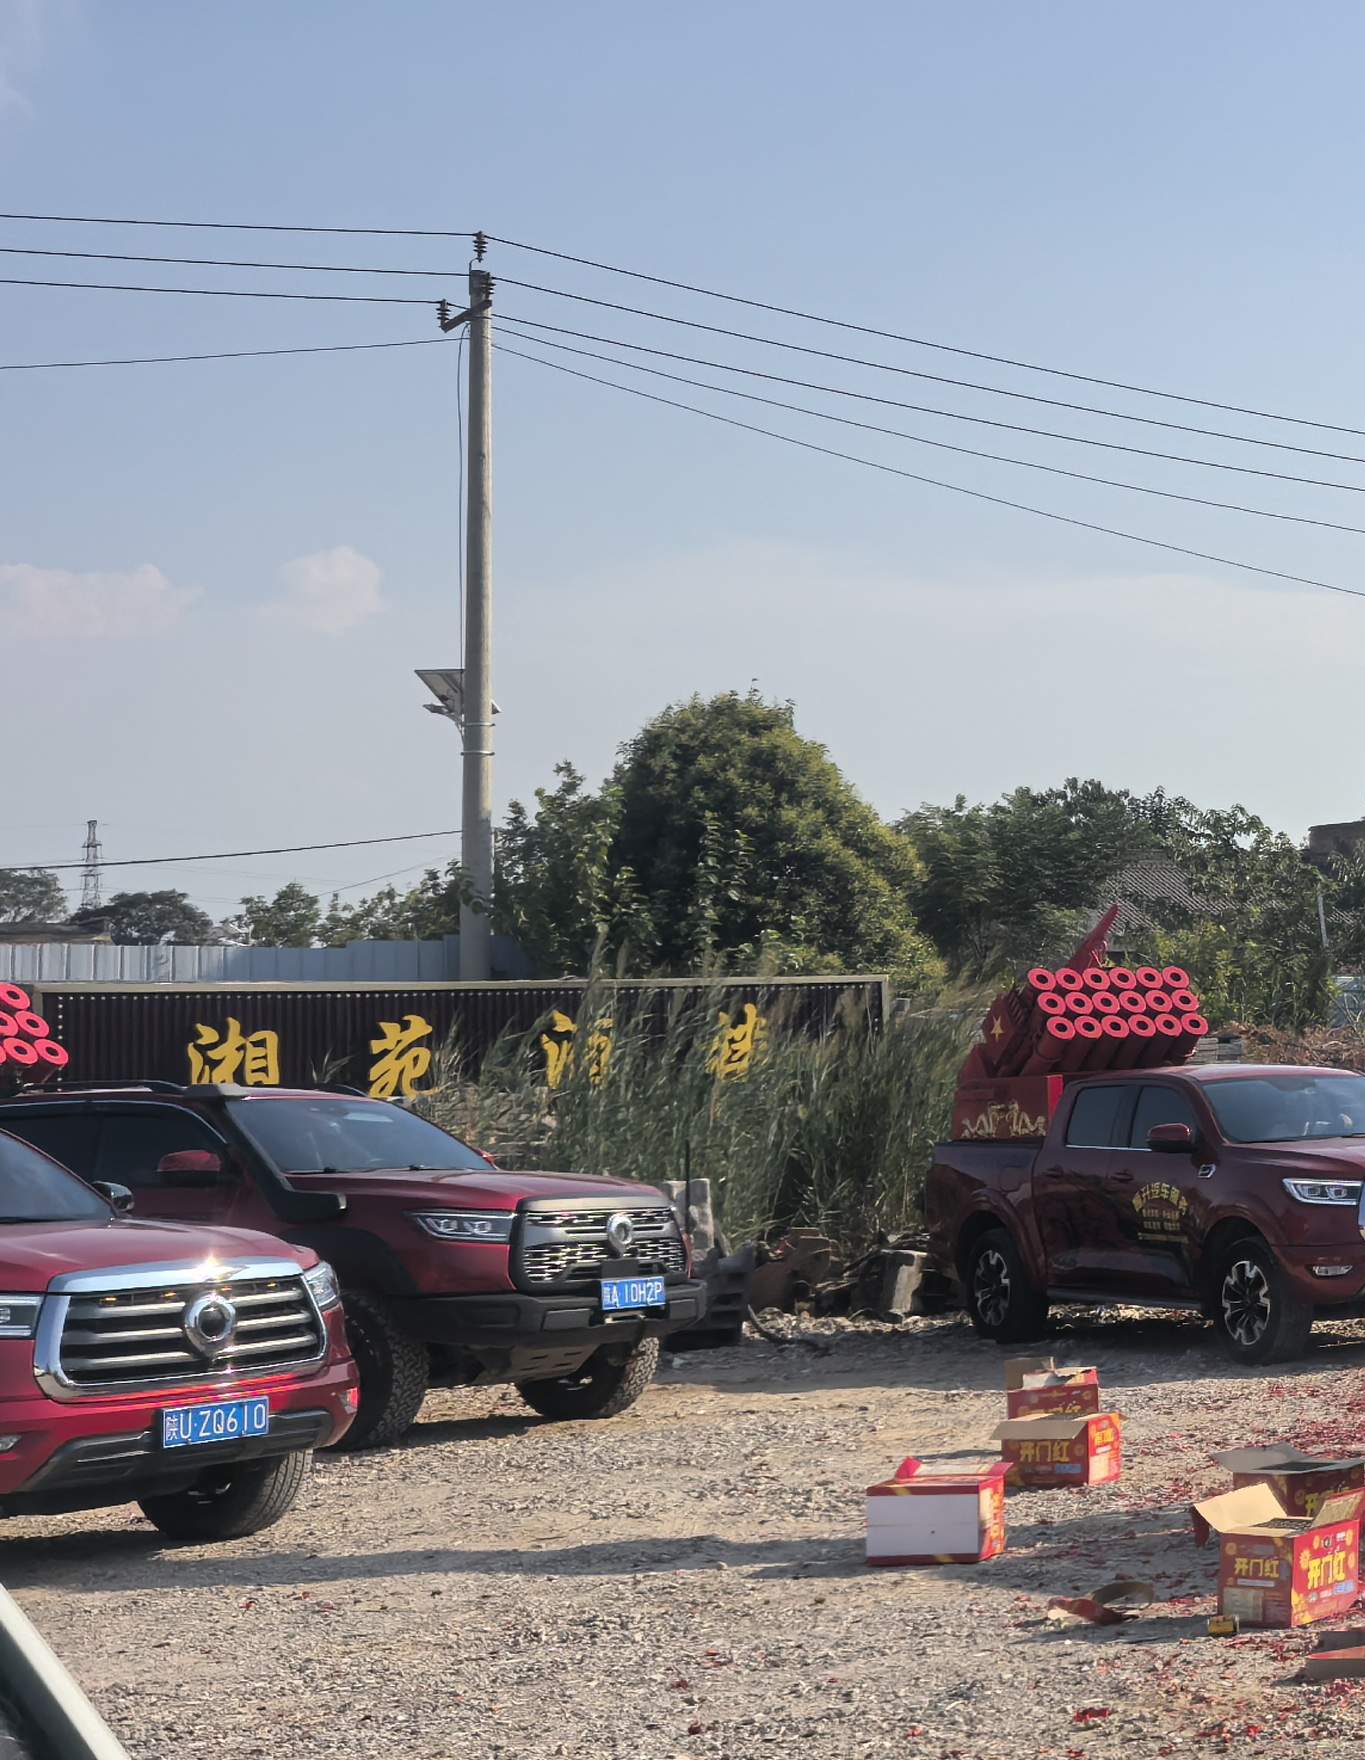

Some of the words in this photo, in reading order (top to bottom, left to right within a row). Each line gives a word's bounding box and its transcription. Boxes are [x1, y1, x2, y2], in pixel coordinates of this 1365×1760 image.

[1234, 1556, 1280, 1578] 开门红
[1306, 1549, 1347, 1590] 开门红
